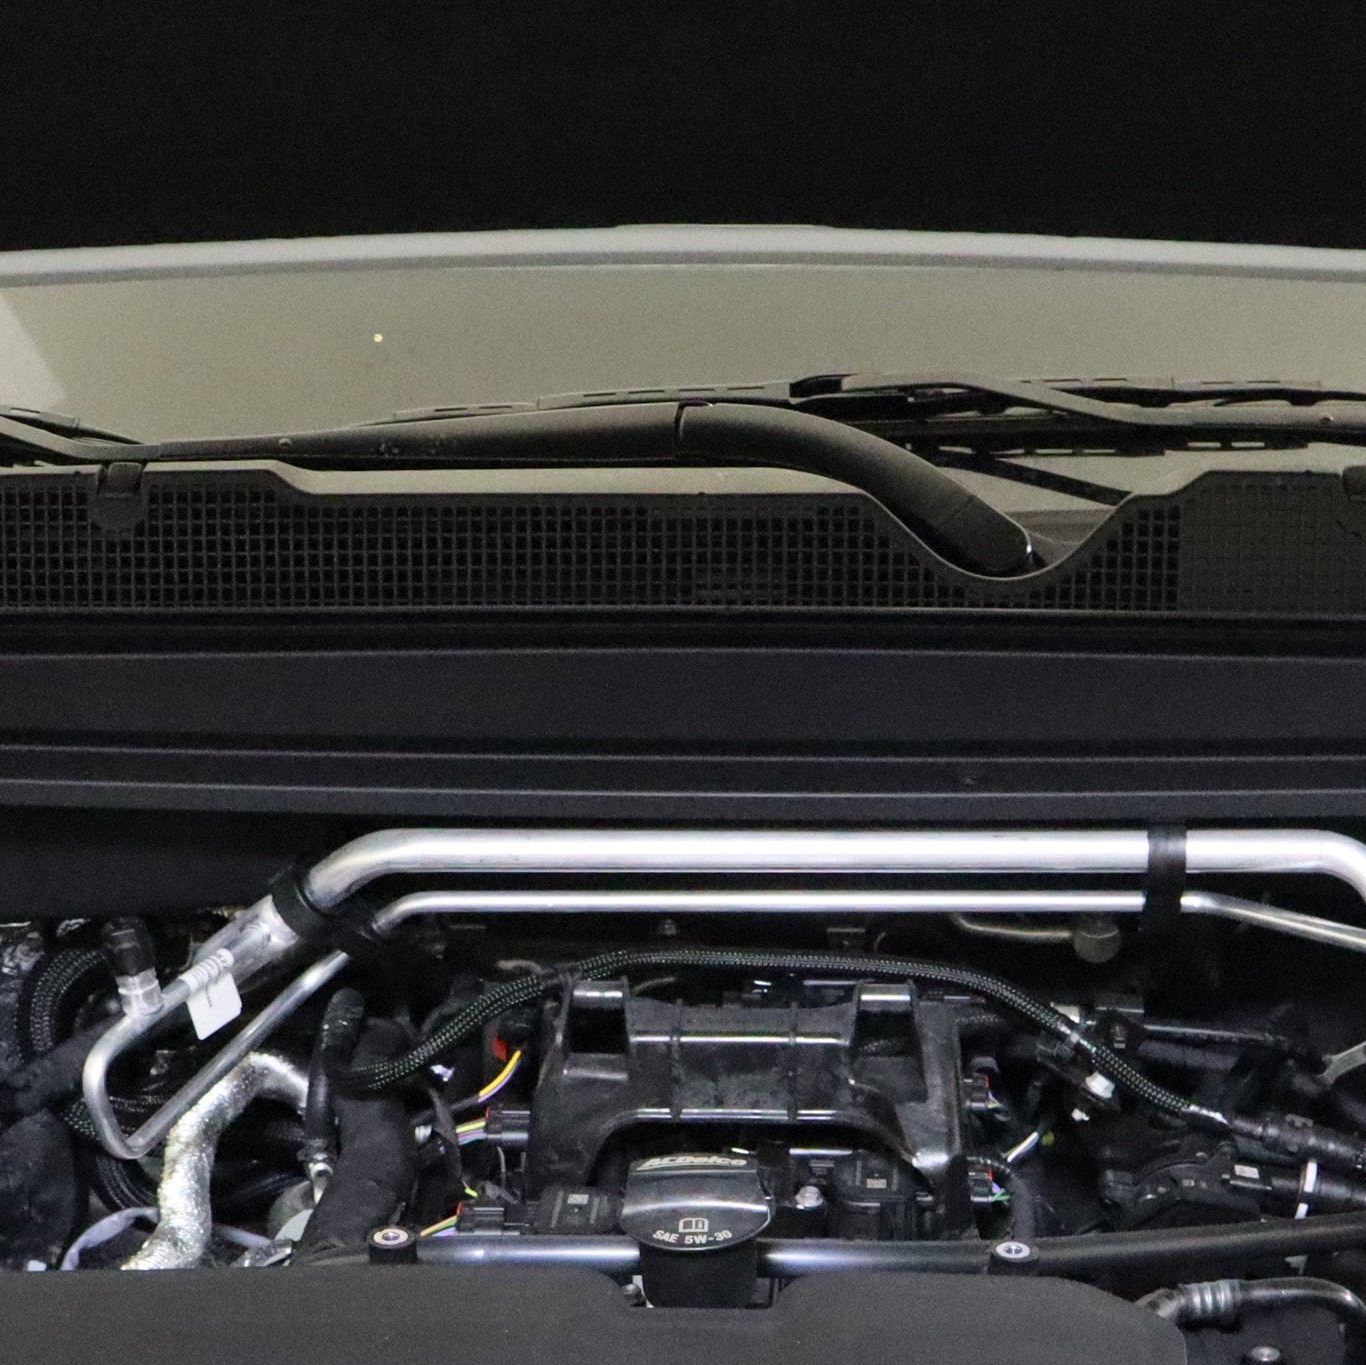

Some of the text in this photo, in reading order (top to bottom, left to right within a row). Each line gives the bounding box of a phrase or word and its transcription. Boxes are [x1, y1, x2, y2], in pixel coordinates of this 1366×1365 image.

[636, 1156, 748, 1171] ACDelco
[652, 1229, 733, 1245] SAE 5W-30
